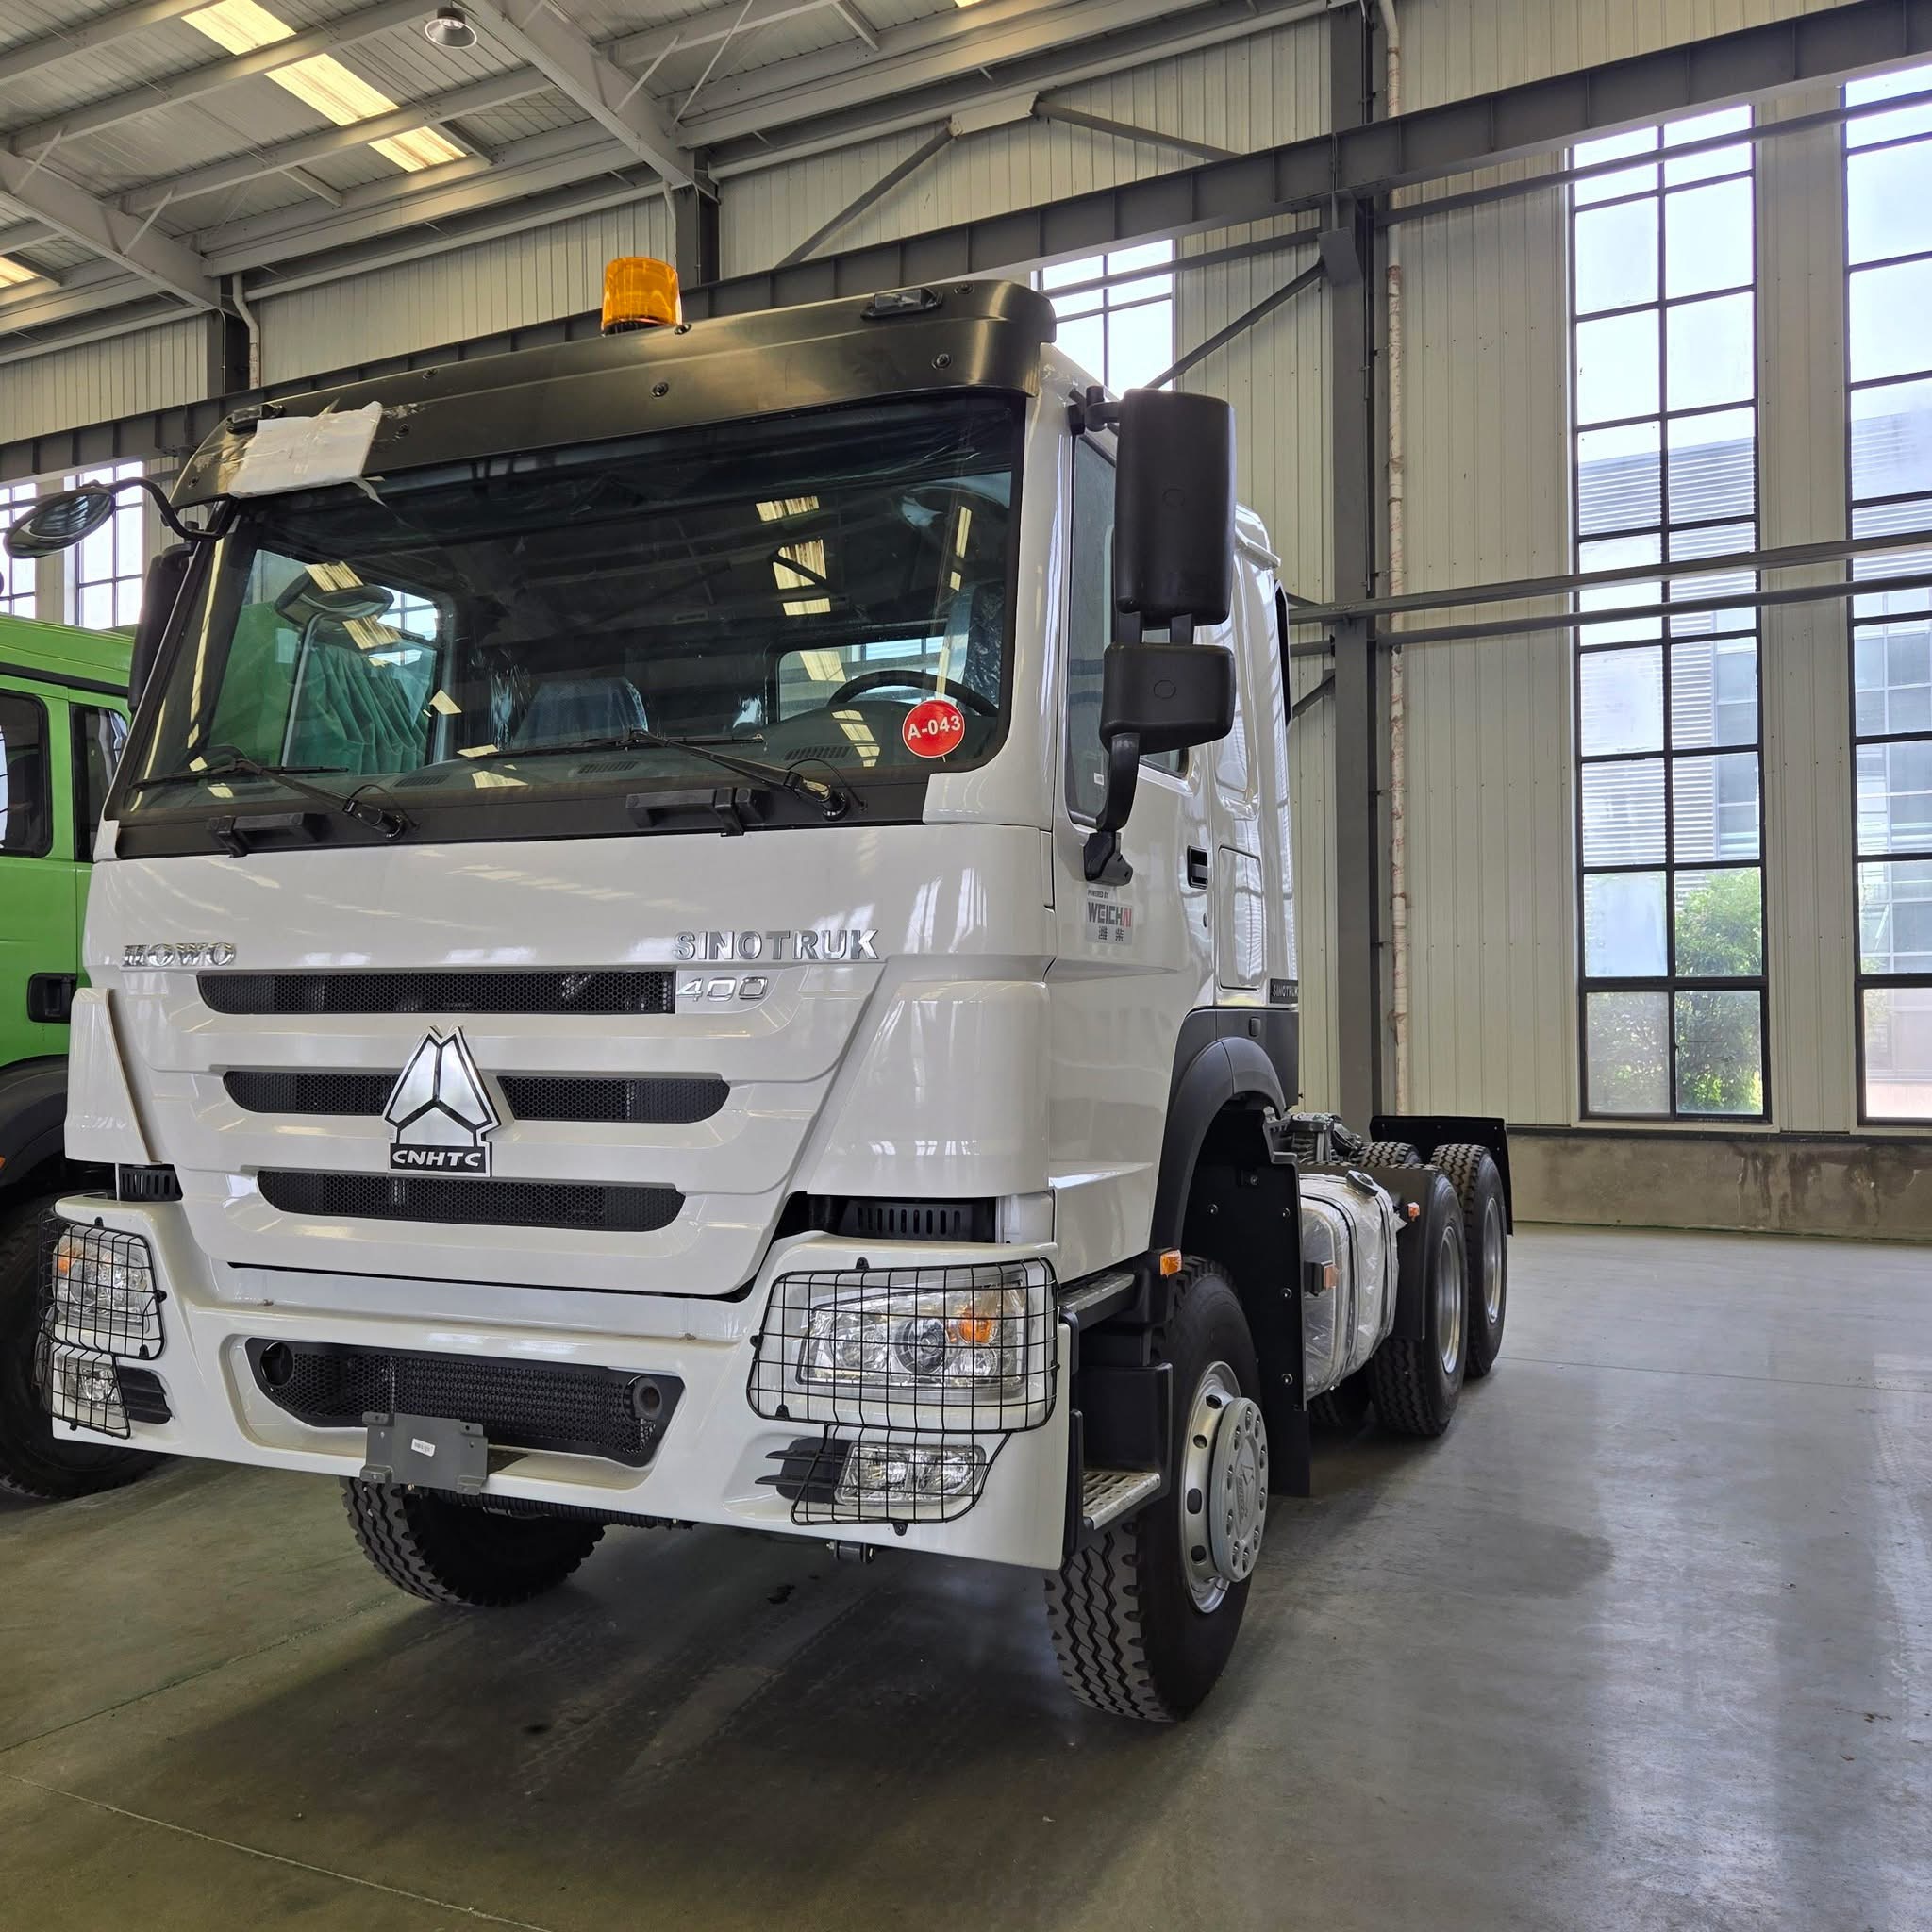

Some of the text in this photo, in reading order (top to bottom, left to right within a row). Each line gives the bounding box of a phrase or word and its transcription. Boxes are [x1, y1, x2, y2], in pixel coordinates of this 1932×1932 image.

[908, 715, 961, 741] A-043
[1088, 901, 1132, 928] WEICHAI
[123, 942, 236, 967] HOWO
[672, 929, 879, 961] SINOTRUK
[676, 976, 769, 1002] 400
[392, 1150, 482, 1167] CNHTC
